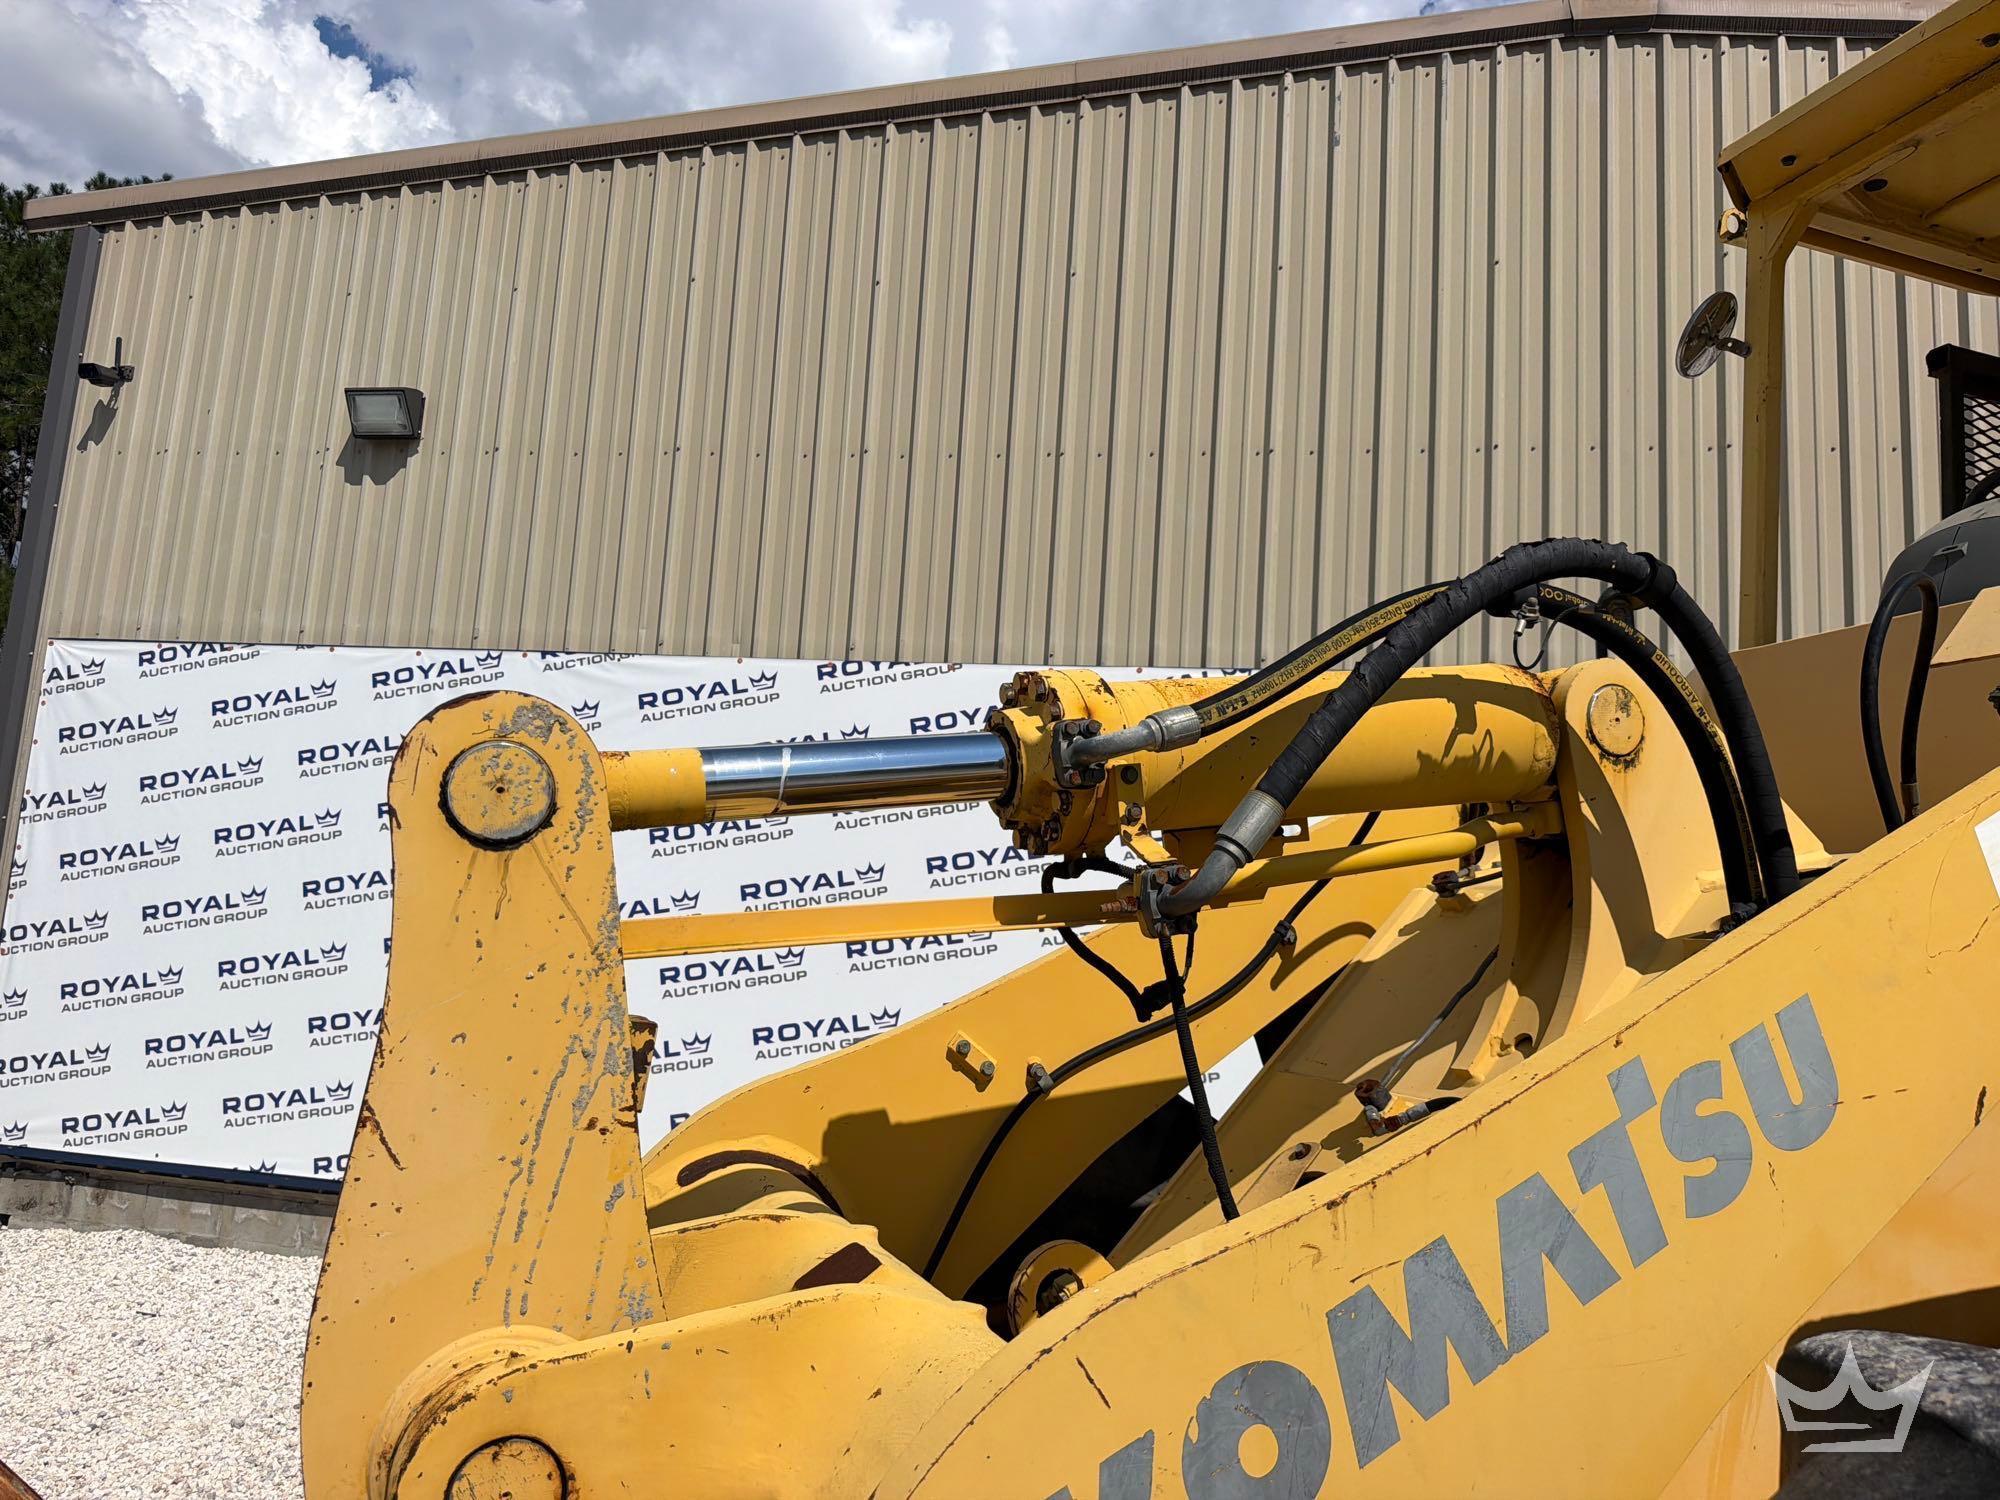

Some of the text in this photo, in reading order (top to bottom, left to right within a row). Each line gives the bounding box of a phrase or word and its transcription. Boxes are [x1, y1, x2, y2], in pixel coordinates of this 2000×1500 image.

[139, 650, 260, 680] AUCTION GROUP
[372, 657, 475, 688] ROYAL
[542, 653, 616, 673] AUCTION
[56, 678, 106, 694] GROUP
[373, 671, 504, 701] AUCTION GROUP
[819, 663, 963, 694] AUCTION GROUP
[211, 686, 310, 716] ROYAL
[638, 678, 748, 710] ROYAL
[641, 692, 780, 723] AUCTION GROUP
[58, 713, 152, 743] ROYAL
[212, 699, 338, 729] AUCTION GROUP
[59, 727, 178, 755] AUCTION GROUP
[298, 736, 400, 766] ROYAL
[139, 762, 236, 792] ROYAL
[299, 759, 368, 779] AUCTION
[20, 789, 82, 812] YAL
[140, 776, 264, 805] AUCTION GROUP
[20, 803, 107, 825] TION GROUP
[834, 810, 913, 831] AUCTION
[917, 801, 980, 819] GROUP
[214, 815, 314, 845] ROYAL
[215, 829, 343, 858] AUCTION GROUP
[649, 820, 762, 845] ROYAL
[651, 828, 794, 859] AUCTION GROUP
[59, 840, 154, 870] ROYAL
[60, 855, 181, 882] AUCTION GROUP
[740, 870, 855, 902] ROYAL
[929, 868, 1010, 889] AUCTION
[142, 892, 240, 922] ROYAL
[303, 892, 375, 911] AUCTION
[825, 886, 888, 904] GROUP
[143, 907, 268, 935] AUCTION GROUP
[0, 932, 109, 956] UCTION GROUP
[846, 932, 964, 959] ROYAL
[218, 948, 319, 977] ROYAL
[659, 954, 775, 985] ROYAL
[849, 944, 998, 973] AUCTION GROUP
[60, 972, 157, 1000] ROYAL
[219, 964, 348, 991] AUCTION GROUP
[662, 970, 808, 1000] AUCTION GROUP
[61, 987, 184, 1013] AUCTION GROUP
[145, 1027, 245, 1056] ROYAL
[752, 1014, 870, 1046] ROYAL
[146, 1043, 273, 1069] AUCTION GROUP
[755, 1040, 836, 1061] AUCTION
[0, 1065, 111, 1088] UCTION GROUP
[651, 1057, 714, 1075] GROUP
[223, 1087, 325, 1115] ROYAL
[61, 1107, 160, 1135] ROYAL
[224, 1104, 354, 1129] AUCTION GROUP
[63, 1124, 188, 1148] AUCTION GROUP
